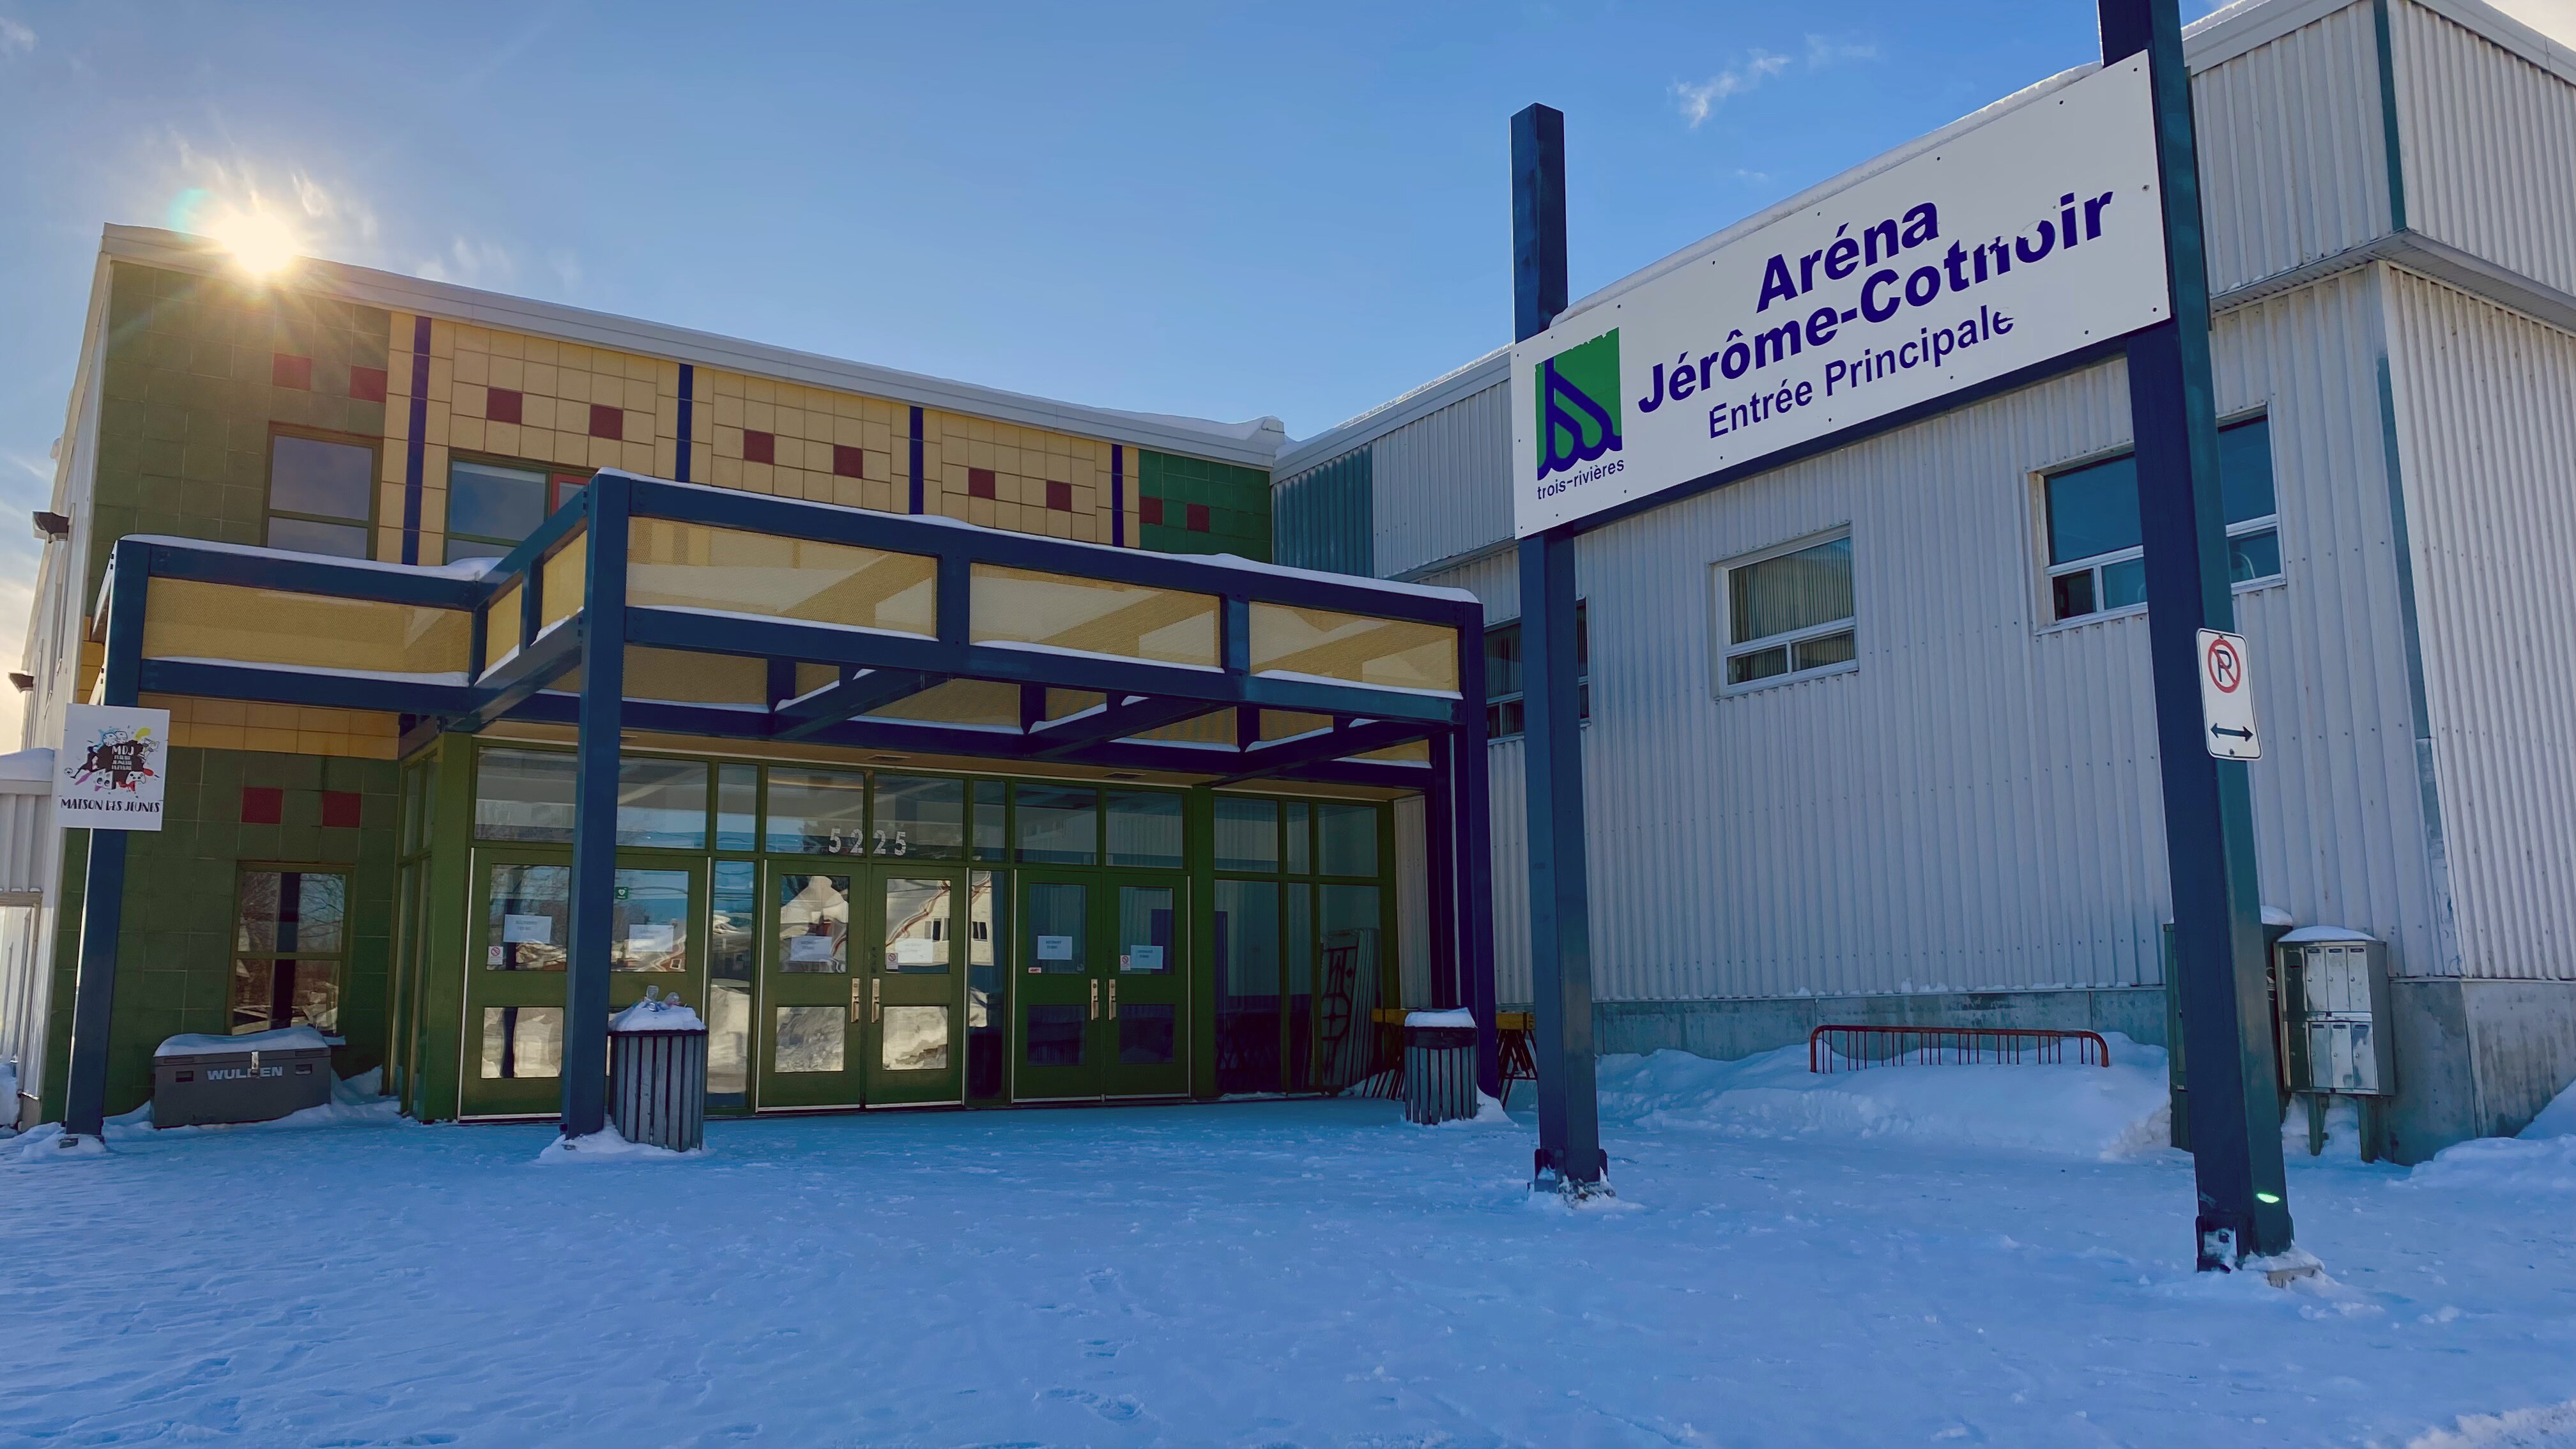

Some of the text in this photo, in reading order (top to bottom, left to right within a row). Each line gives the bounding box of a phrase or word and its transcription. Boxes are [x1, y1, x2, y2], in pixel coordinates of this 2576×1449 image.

[1756, 202, 1939, 313] Aréna
[1638, 191, 2113, 413] Jérôme-Cotnoir
[1709, 305, 2014, 438] Entrée Principale
[1537, 459, 1624, 500] trois-rivières
[111, 745, 134, 756] MDJ
[61, 799, 103, 811] MAISON
[124, 801, 160, 813] JEUNES
[829, 828, 907, 856] 5225
